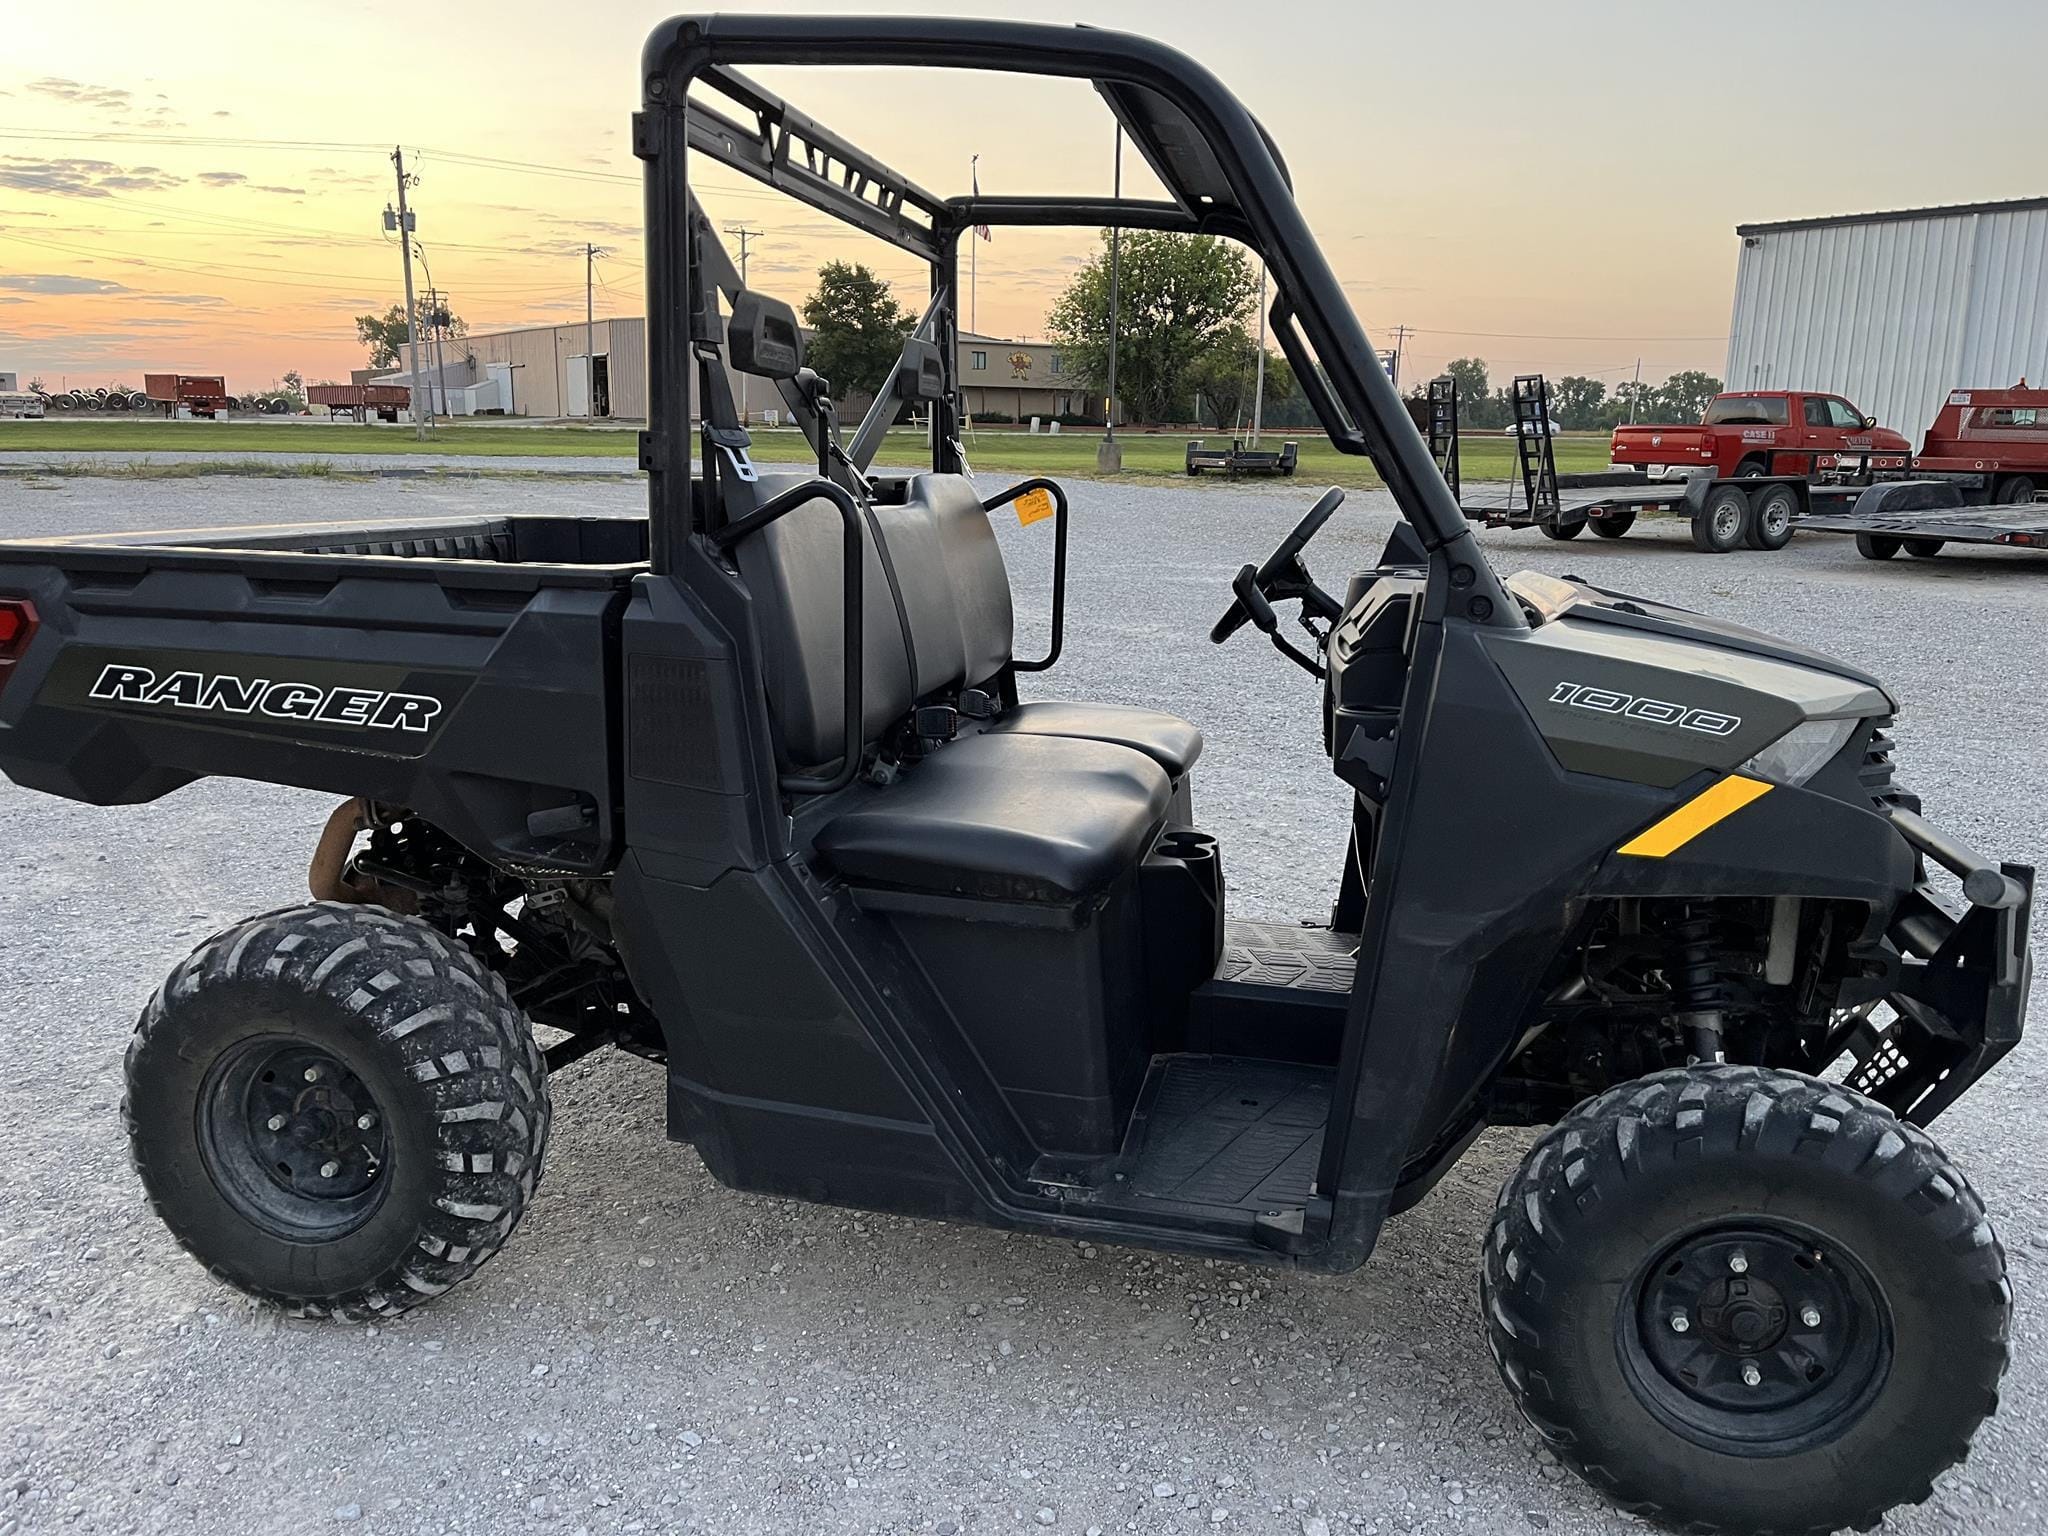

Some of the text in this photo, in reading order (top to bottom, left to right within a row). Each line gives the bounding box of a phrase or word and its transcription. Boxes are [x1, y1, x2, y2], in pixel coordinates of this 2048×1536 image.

[1743, 430, 1768, 439] CASE
[89, 664, 442, 732] RANGER
[1549, 682, 1742, 736] 1000
